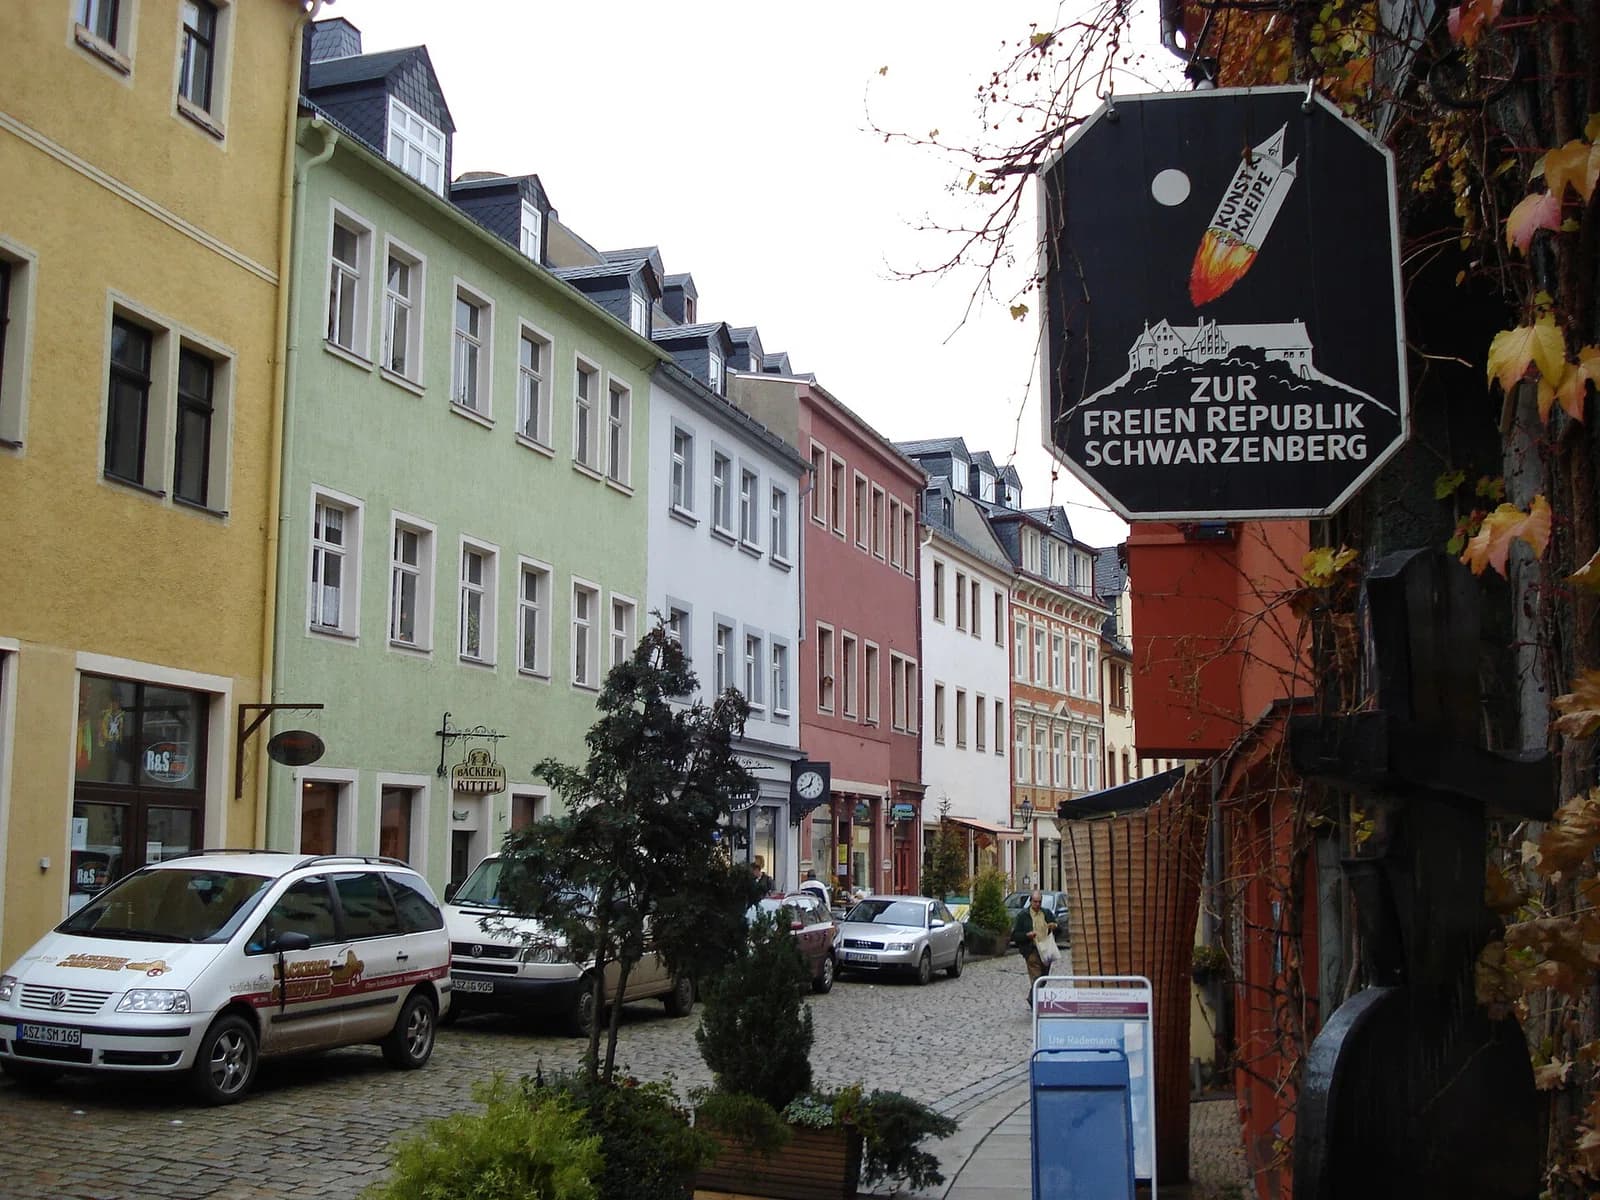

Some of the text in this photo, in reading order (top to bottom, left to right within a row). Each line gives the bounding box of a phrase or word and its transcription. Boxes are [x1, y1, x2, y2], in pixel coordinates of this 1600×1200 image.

[1215, 169, 1253, 228] KUNST
[1231, 171, 1273, 237] KNEIPE
[1190, 375, 1257, 402] ZUR
[1083, 403, 1365, 436] FREIEN REPUBLIK
[1085, 434, 1368, 467] SCHWARZENBERG
[146, 750, 170, 772] R&S
[457, 780, 501, 793] KITTEL
[77, 868, 96, 885] R&S
[23, 1024, 40, 1040] ASZ
[46, 1027, 59, 1041] SM
[61, 1027, 80, 1043] 165
[1067, 1035, 1118, 1046] Rademann
